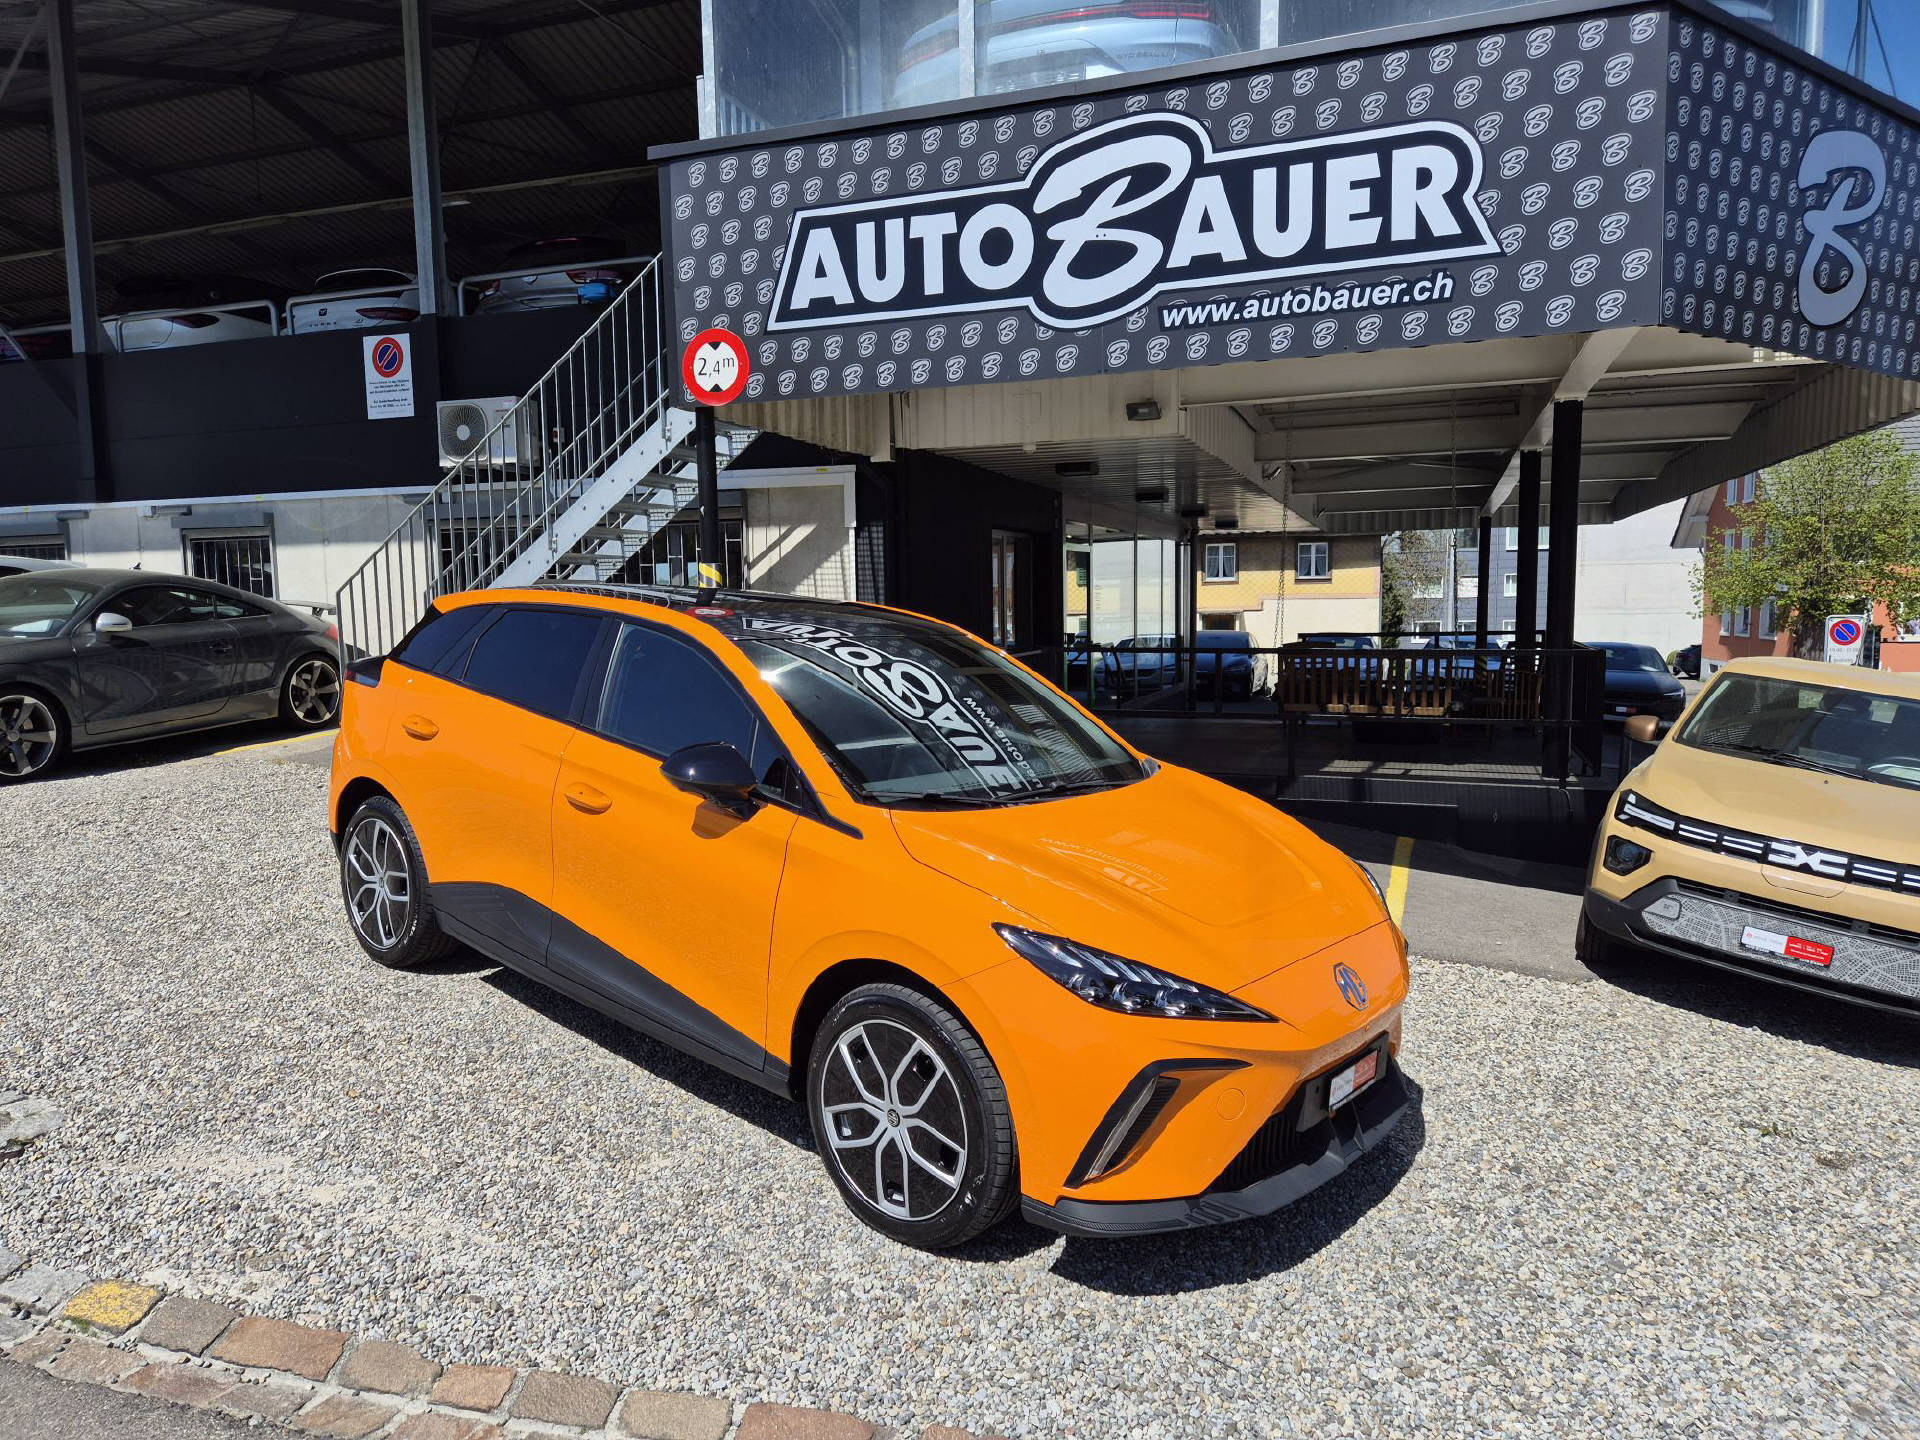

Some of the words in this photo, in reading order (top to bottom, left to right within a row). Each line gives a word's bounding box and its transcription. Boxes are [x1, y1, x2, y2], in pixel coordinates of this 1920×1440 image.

[790, 203, 1034, 309] AUTO
[1034, 136, 1462, 307] BAUER
[1163, 272, 1453, 327] www.autobauer.ch
